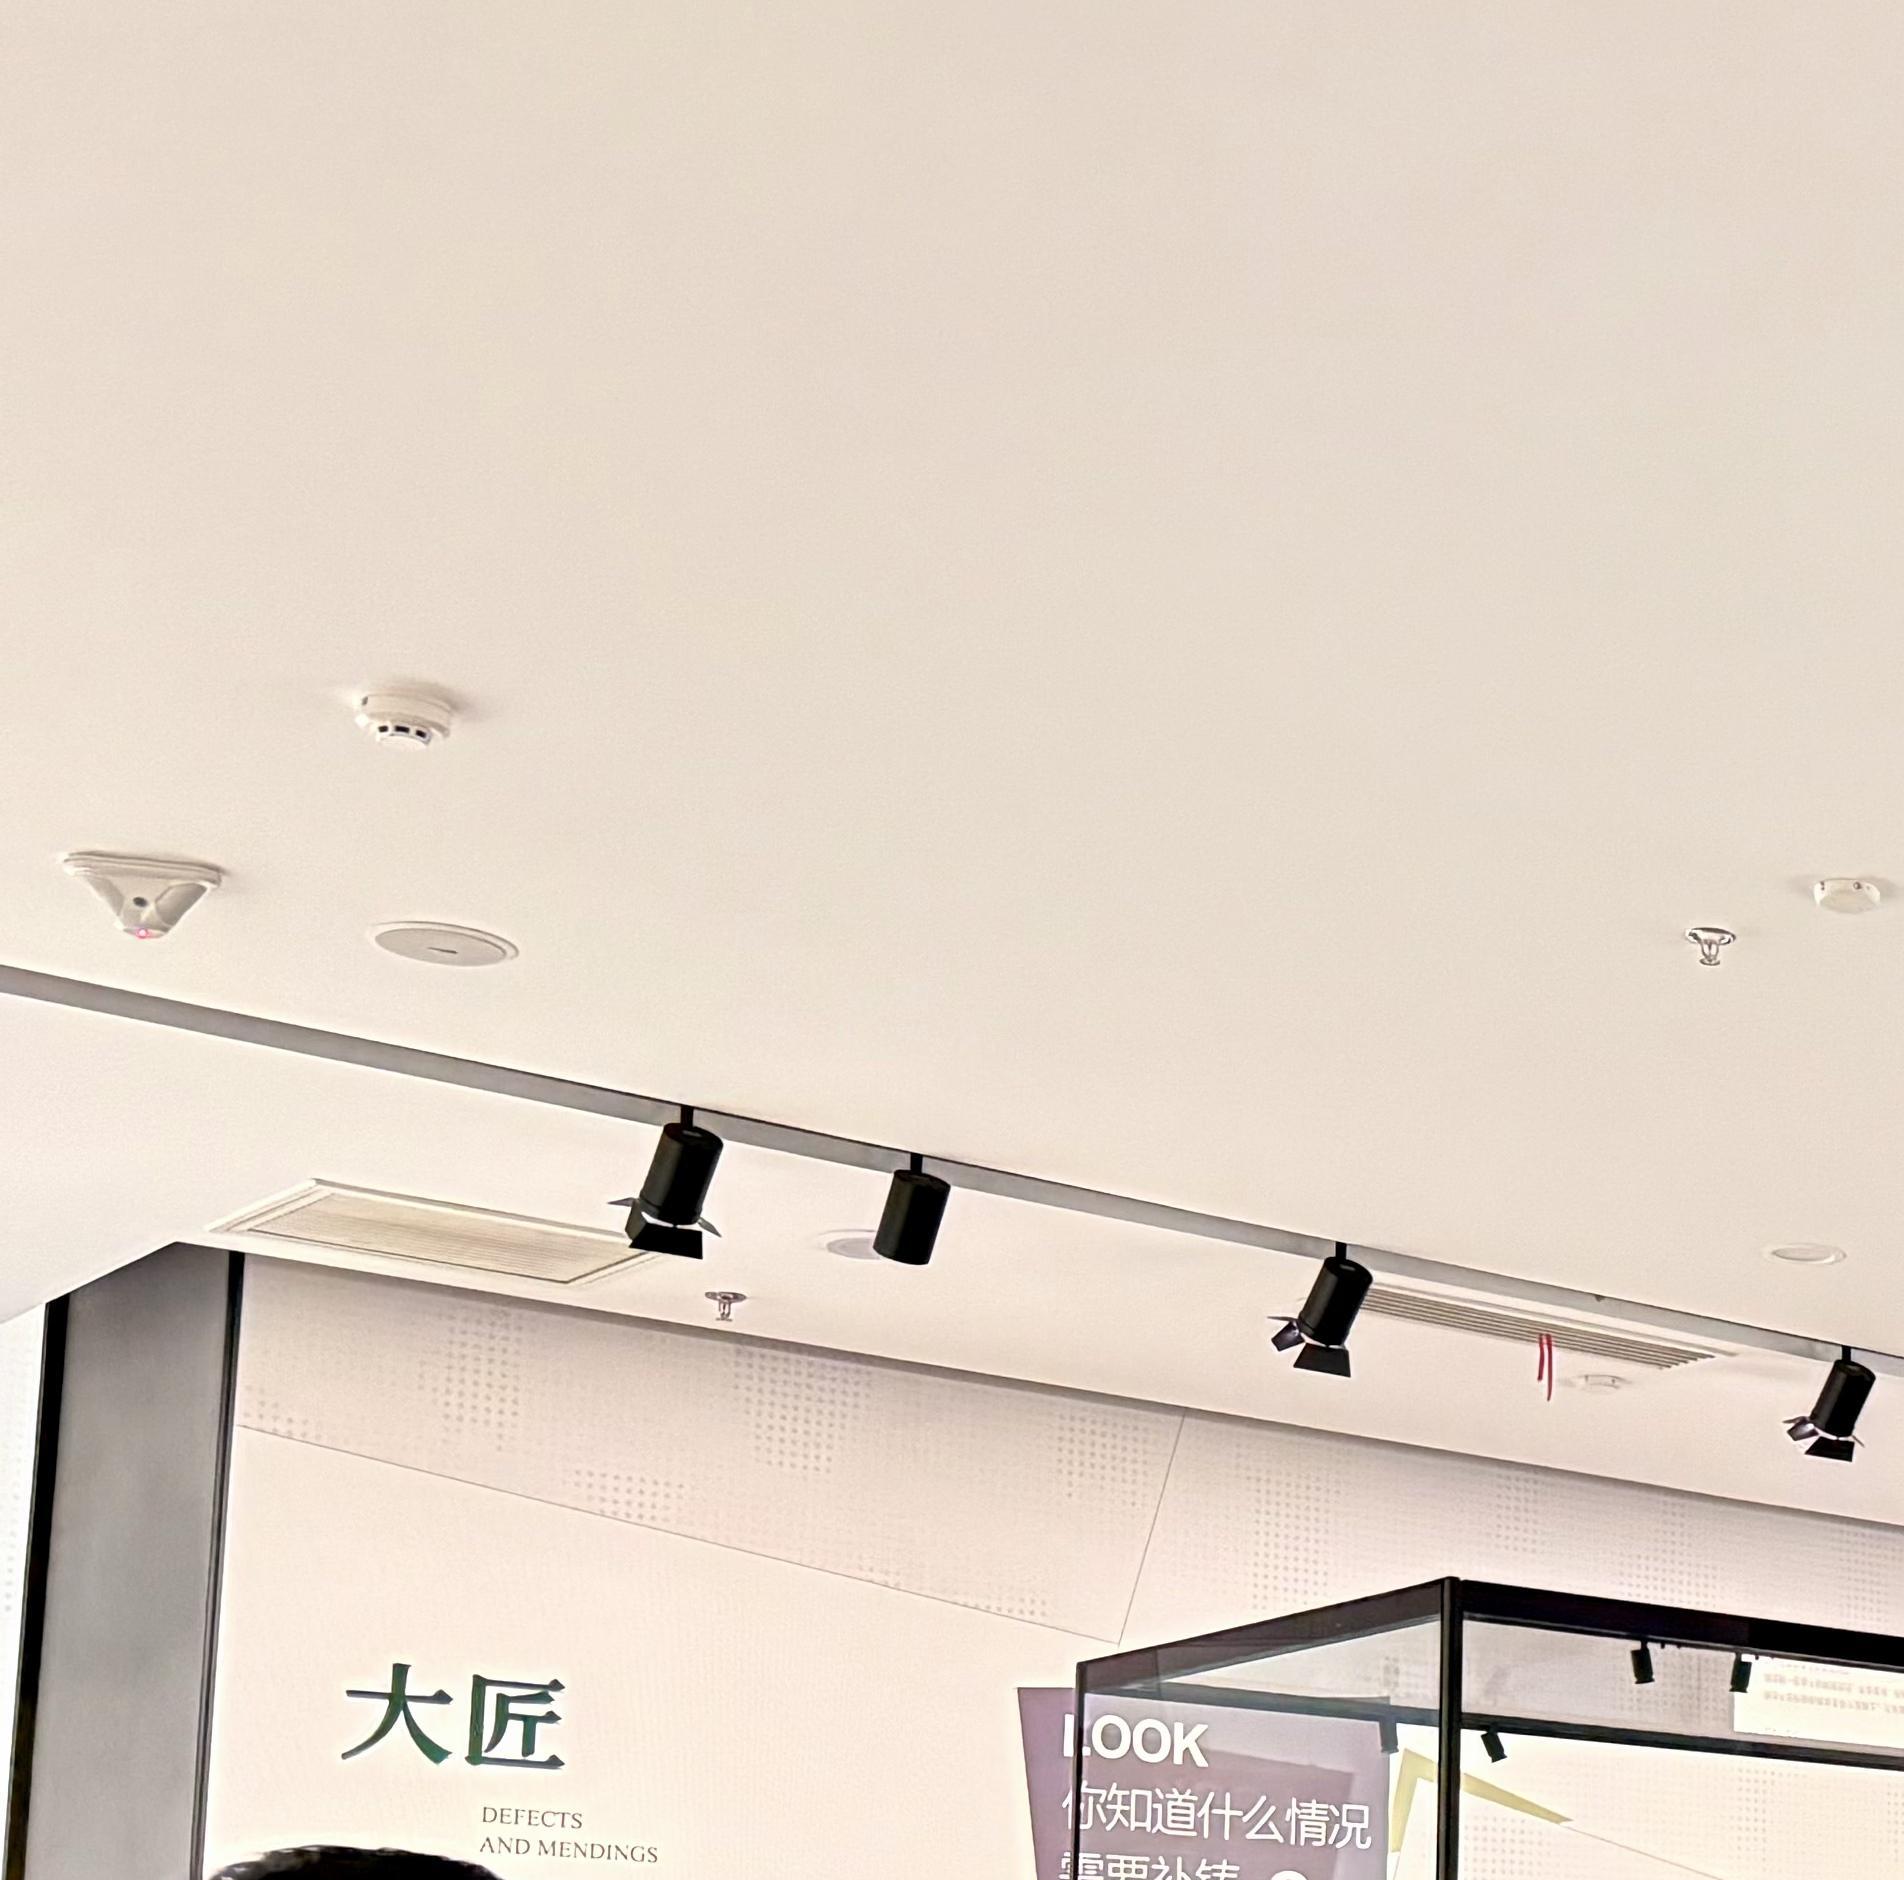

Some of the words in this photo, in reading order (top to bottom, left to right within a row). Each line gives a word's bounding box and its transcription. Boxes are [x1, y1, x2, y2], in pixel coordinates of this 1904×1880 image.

[341, 1663, 566, 1769] 大匠
[1063, 1714, 1209, 1768] LOOK
[481, 1805, 583, 1830] DEFECTS
[1062, 1780, 1372, 1850] 你知道什么情况
[480, 1836, 530, 1857] AND
[537, 1840, 659, 1864] MENDINGS
